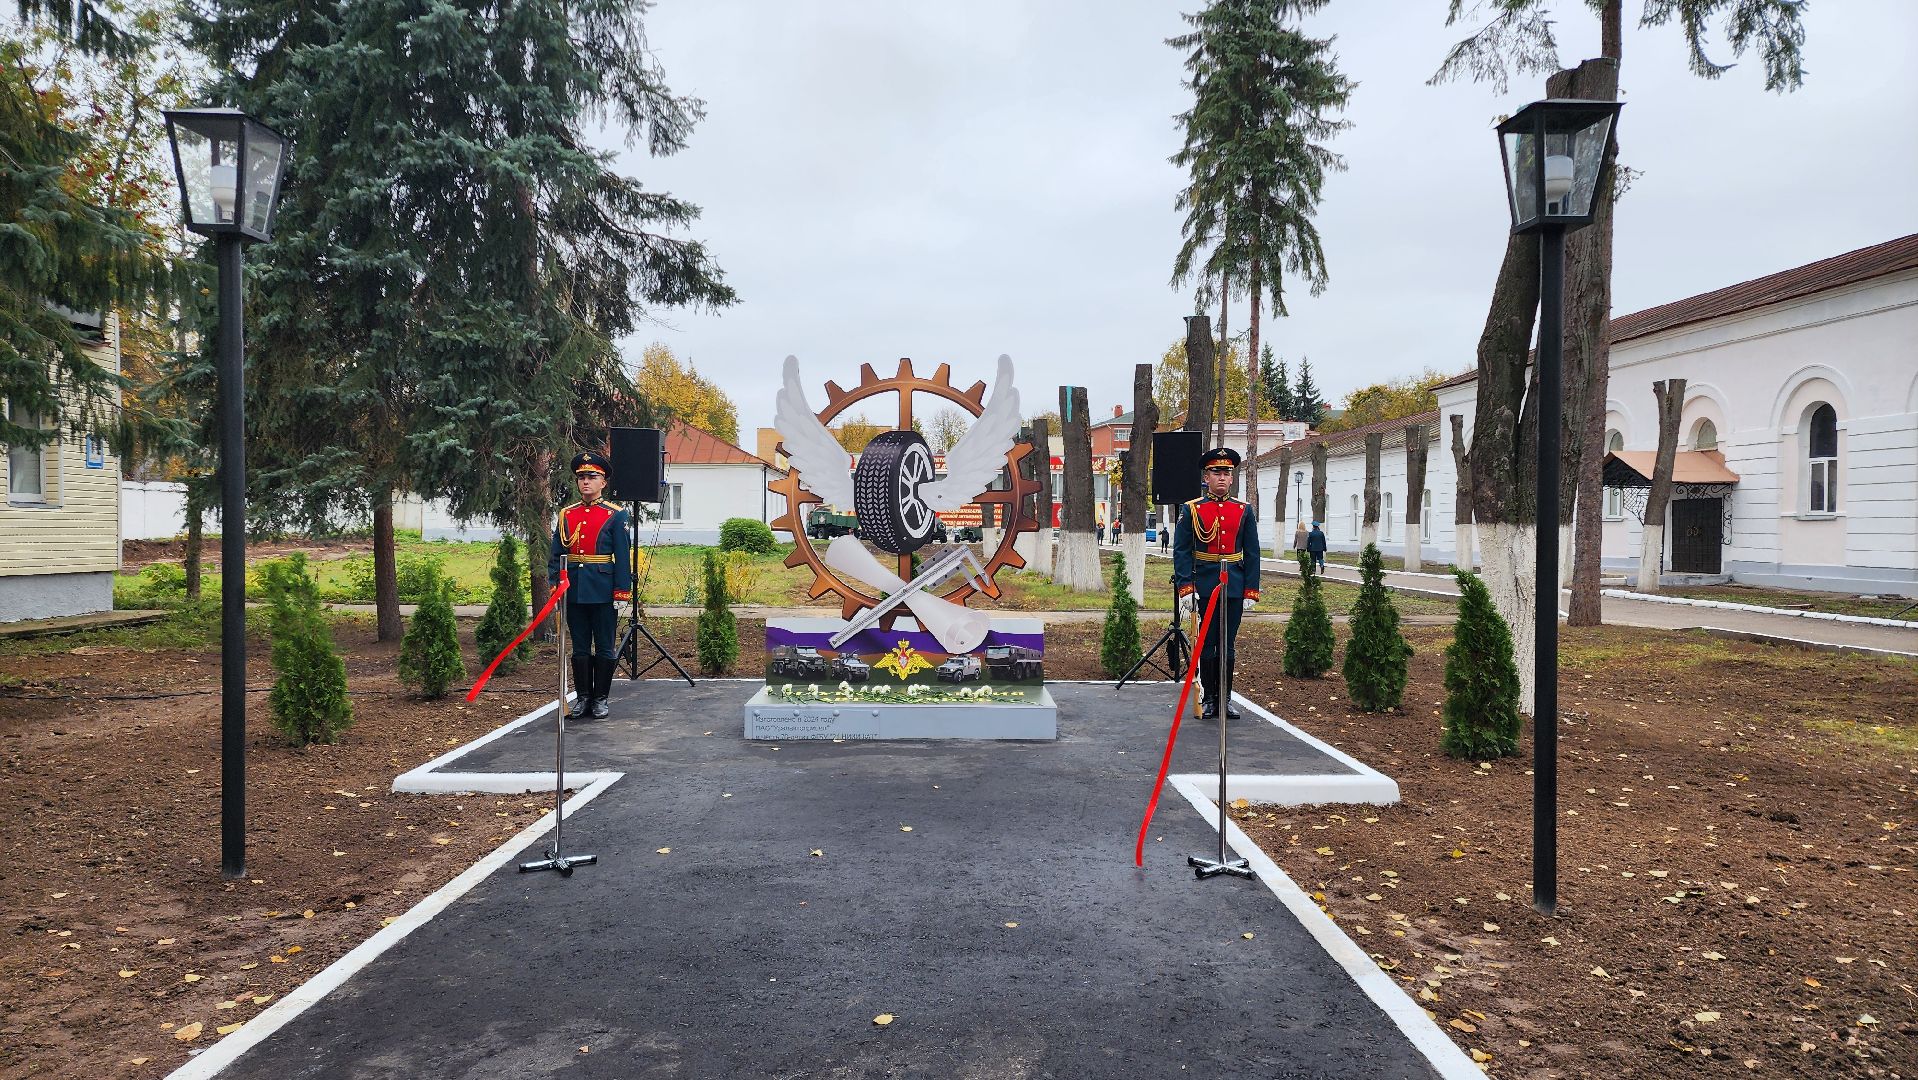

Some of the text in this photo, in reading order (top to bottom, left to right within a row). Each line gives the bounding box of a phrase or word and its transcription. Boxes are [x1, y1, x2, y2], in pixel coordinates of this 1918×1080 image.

[755, 715, 796, 723] Изготовлено
[804, 715, 819, 723] 2024
[820, 717, 836, 725] году
